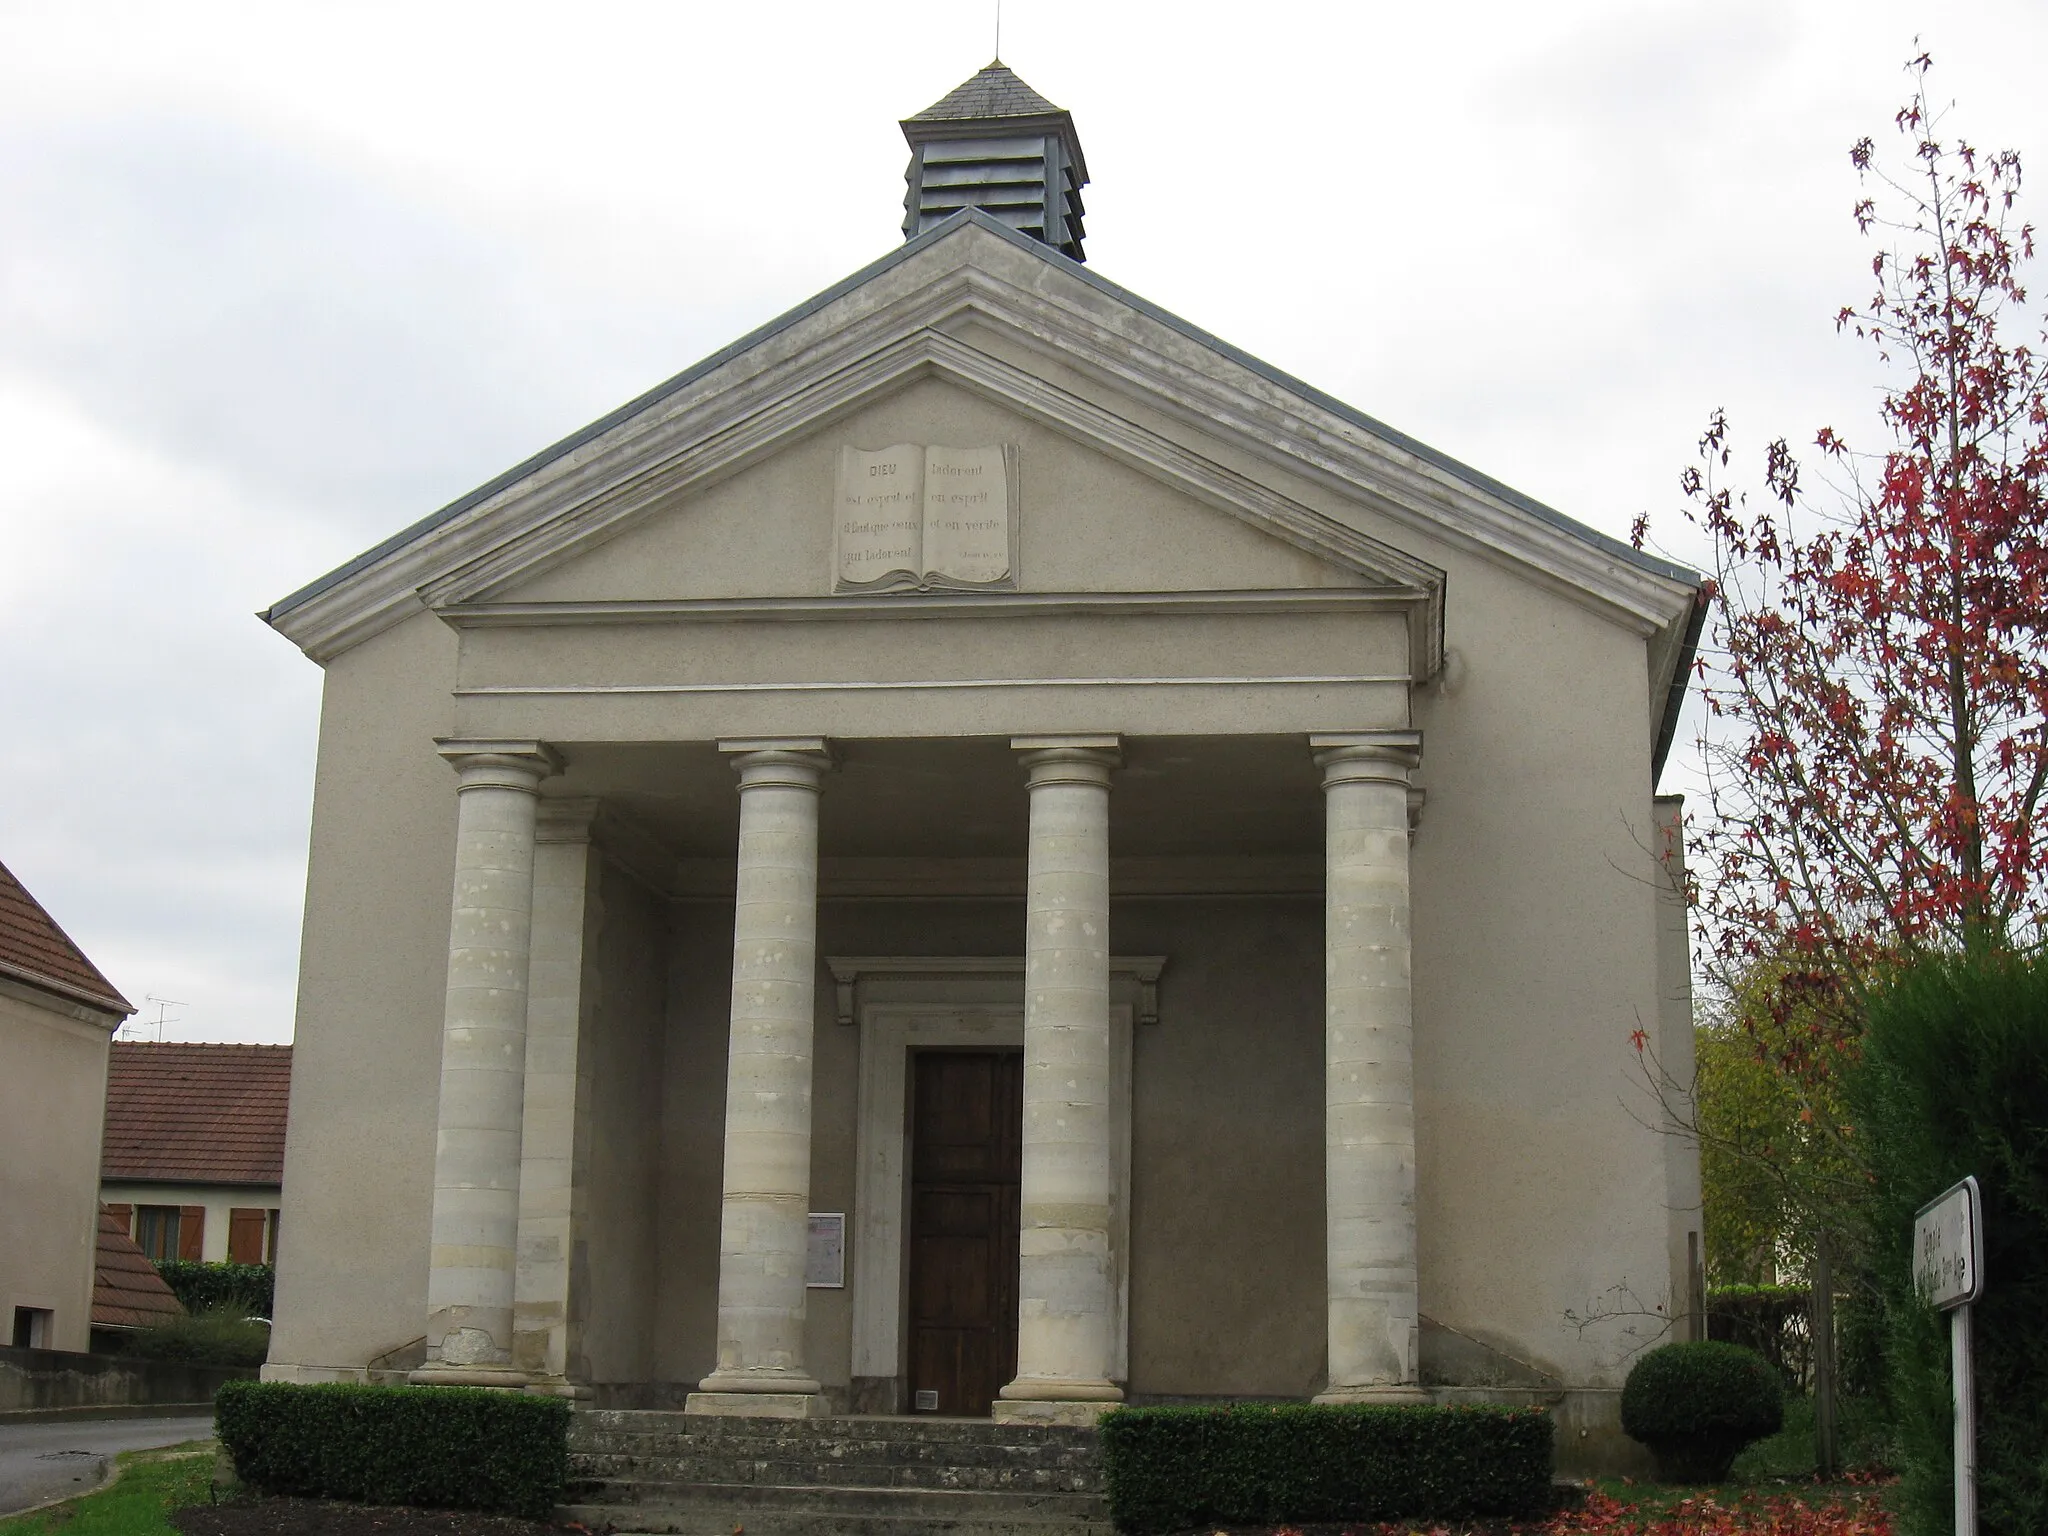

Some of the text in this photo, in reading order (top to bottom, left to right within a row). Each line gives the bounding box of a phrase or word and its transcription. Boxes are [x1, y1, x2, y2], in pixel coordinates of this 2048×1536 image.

[870, 464, 896, 476] DIEU
[867, 492, 900, 508] esprit
[952, 492, 987, 507] esprit
